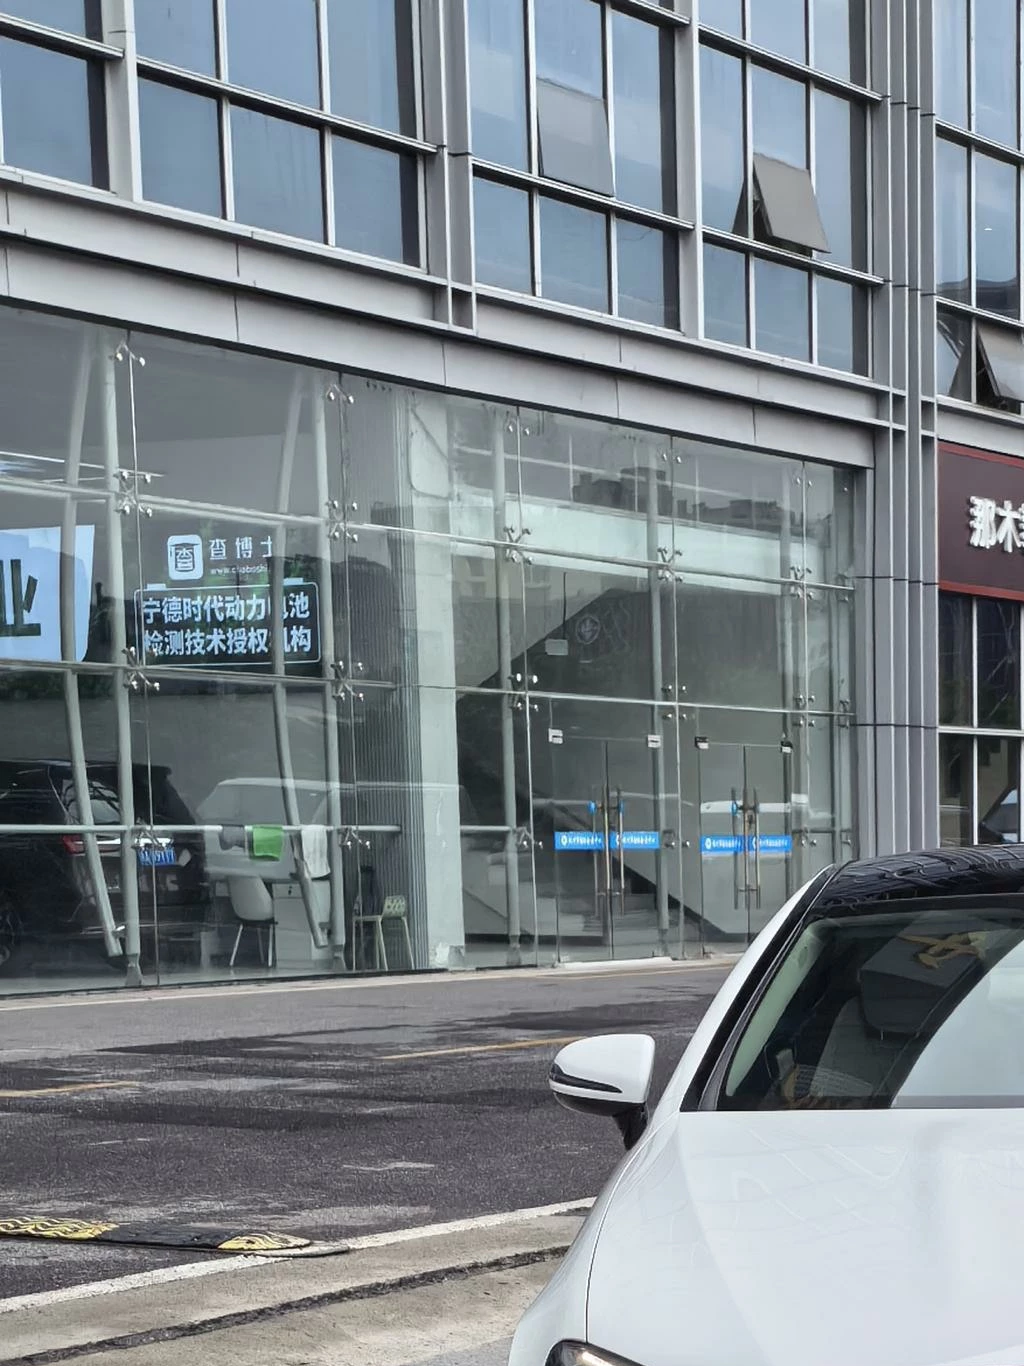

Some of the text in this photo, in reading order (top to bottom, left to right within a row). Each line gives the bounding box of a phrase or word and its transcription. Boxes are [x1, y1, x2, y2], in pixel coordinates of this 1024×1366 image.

[142, 591, 310, 624] 宁德时代动力池
[143, 625, 312, 657] 检测技术授权构
